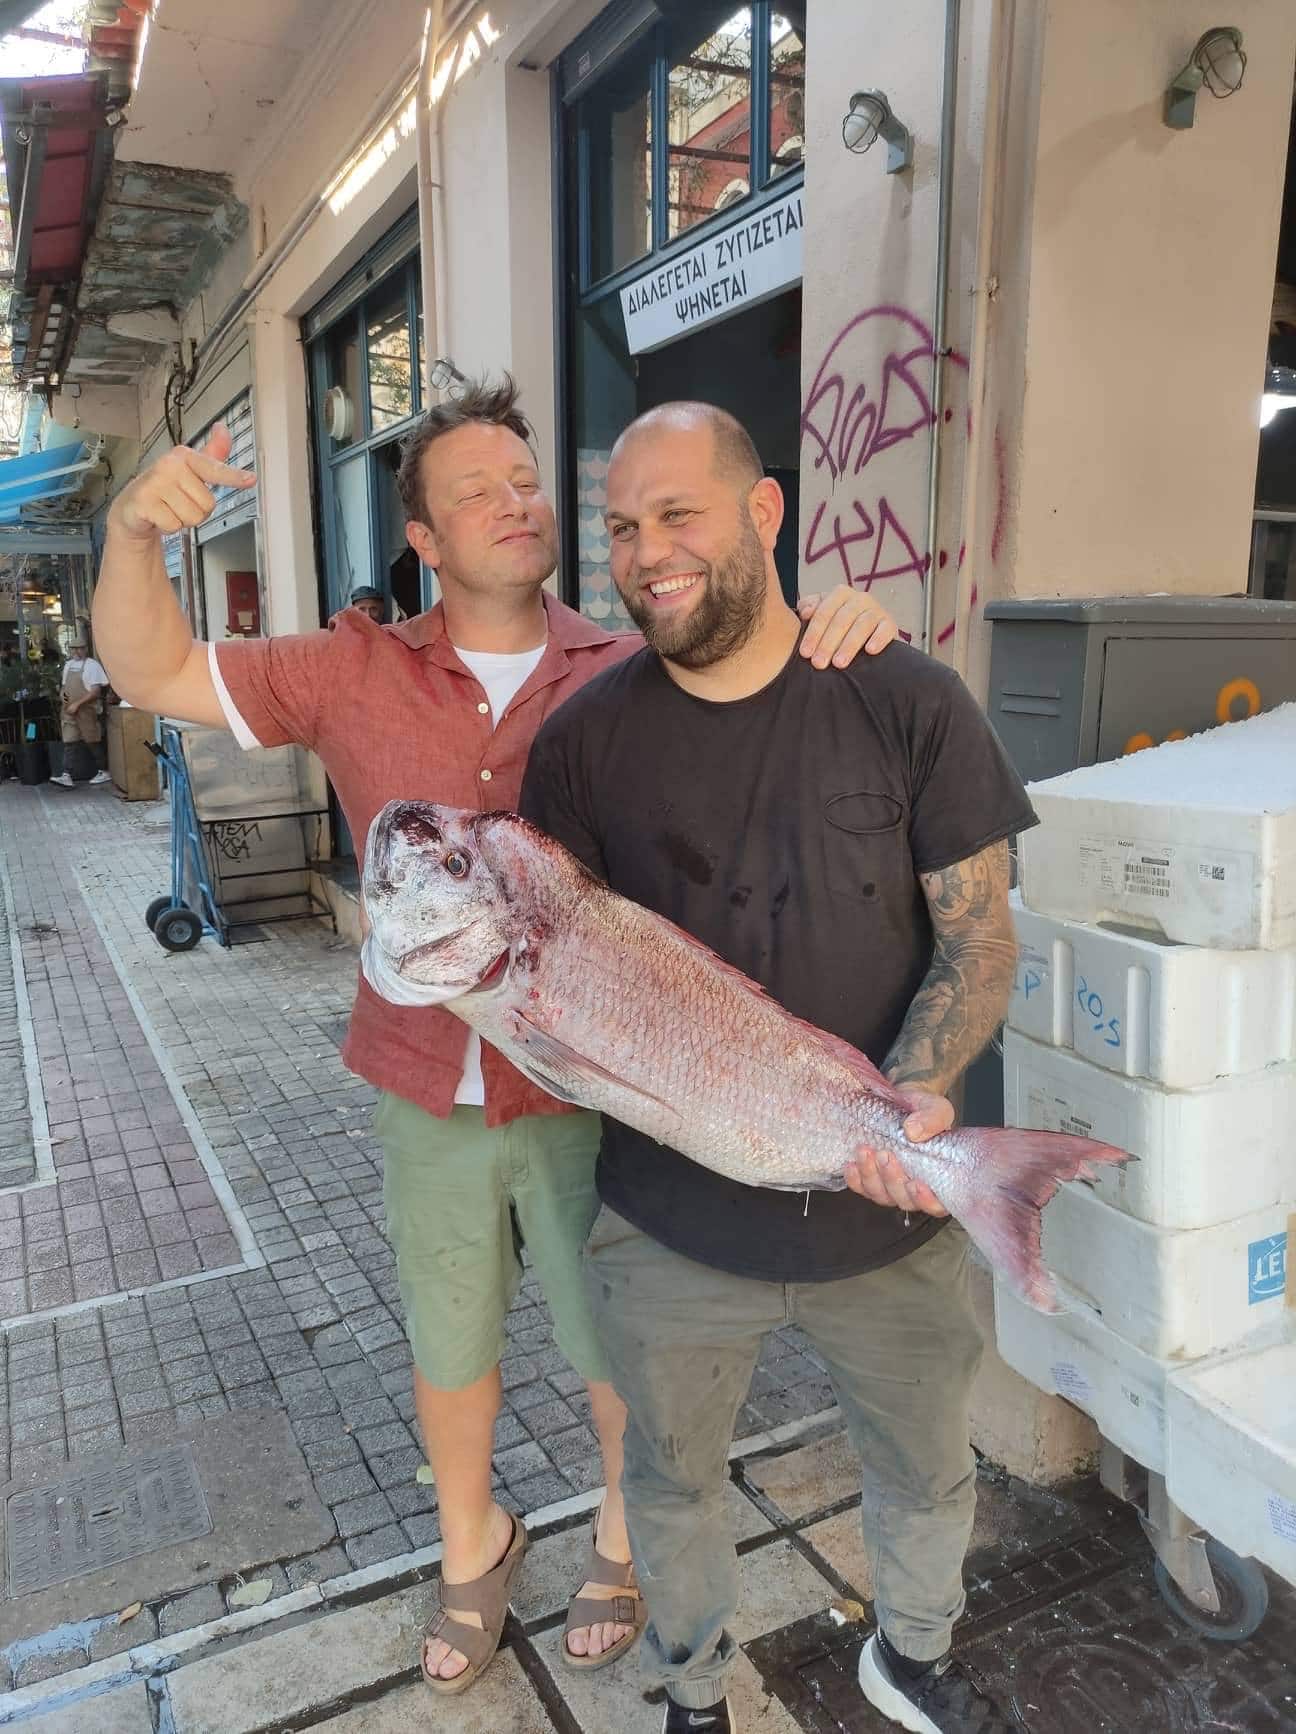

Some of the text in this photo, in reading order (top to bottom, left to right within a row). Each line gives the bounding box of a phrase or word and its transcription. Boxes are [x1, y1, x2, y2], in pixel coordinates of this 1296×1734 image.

[629, 199, 804, 316] ΔΙΑΛΕΓΕΤΑΙ ΖΥΓΙΖΕΤΑΙ
[675, 269, 747, 324] ΨΗΝΕΤΑΙ
